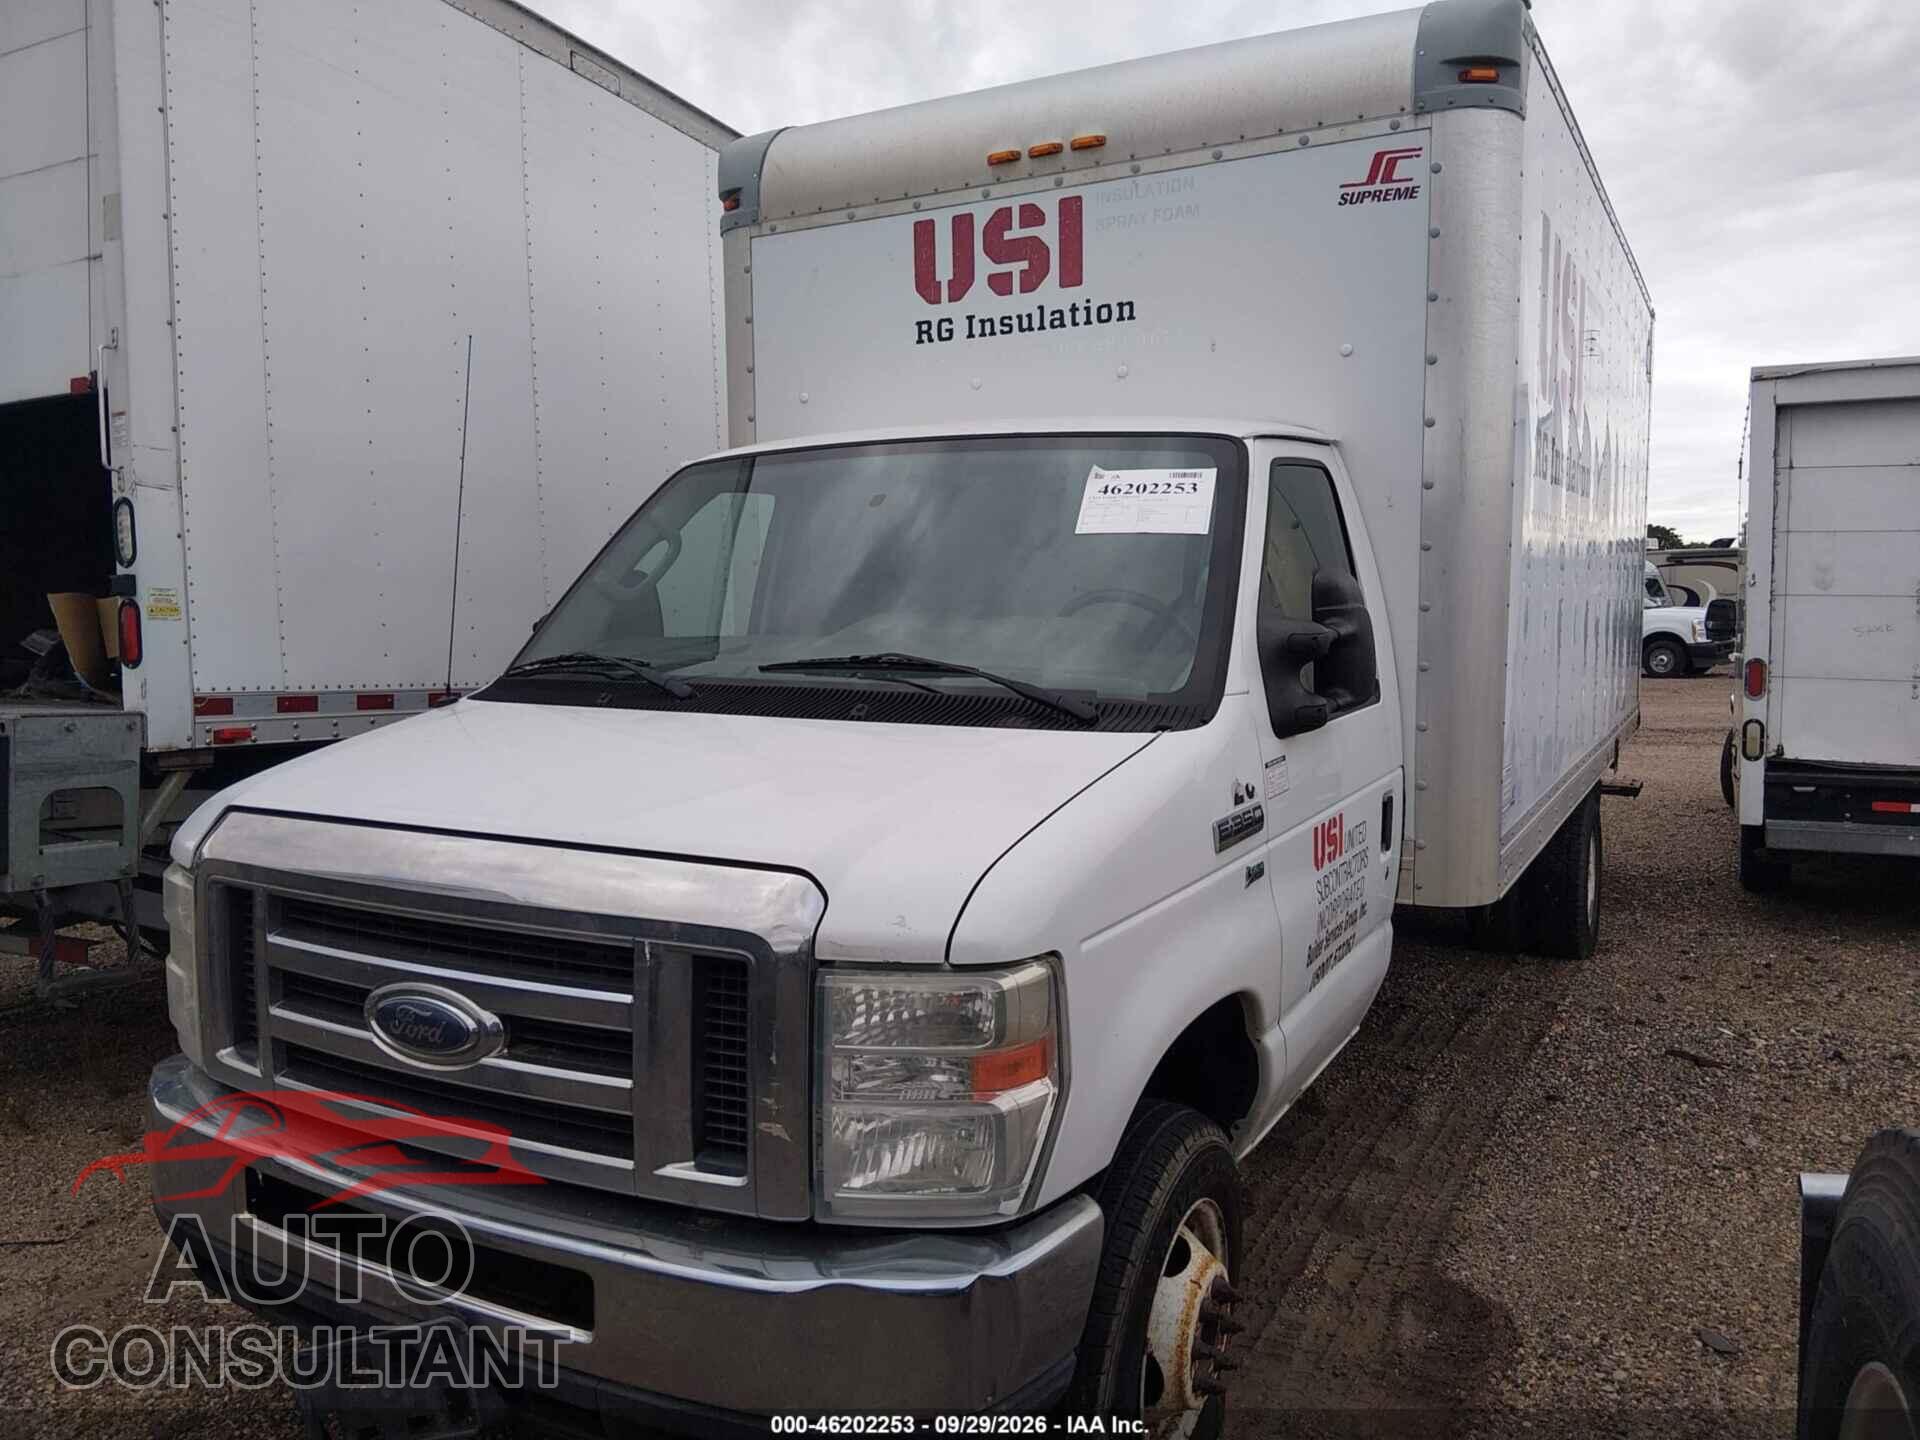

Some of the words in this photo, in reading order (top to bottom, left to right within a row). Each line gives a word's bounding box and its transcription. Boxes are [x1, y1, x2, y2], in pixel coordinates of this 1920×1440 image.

[1096, 174, 1197, 209] INSULATION
[1338, 186, 1421, 207] SUPREME
[1153, 202, 1200, 223] FOAM
[914, 195, 1083, 305] USI
[915, 316, 955, 344] RG
[965, 300, 1136, 340] Insulation
[1098, 482, 1198, 496] 46202253
[1313, 813, 1344, 871] USI
[1344, 820, 1367, 853] UNITED
[1315, 847, 1369, 904] SUBCONTRACTORS
[389, 1004, 446, 1044] Ford
